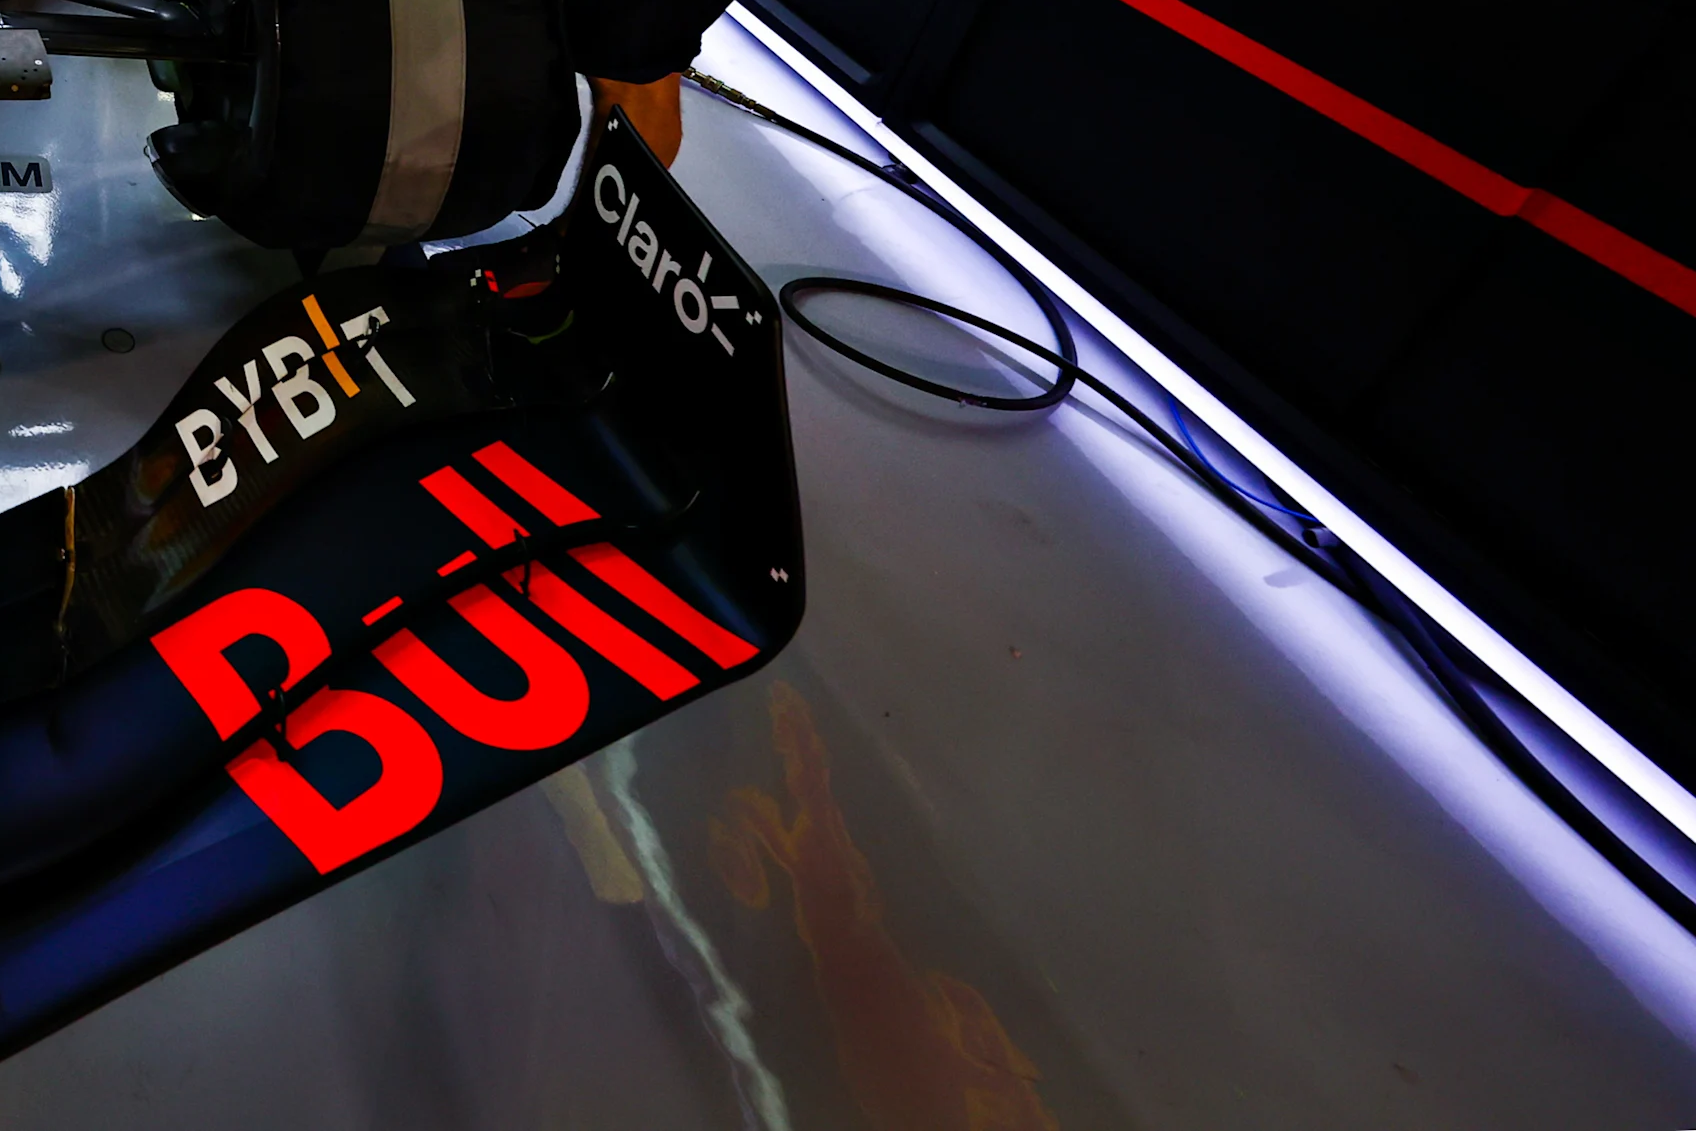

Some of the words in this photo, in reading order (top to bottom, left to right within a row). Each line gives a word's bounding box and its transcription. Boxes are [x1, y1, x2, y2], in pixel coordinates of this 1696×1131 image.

[594, 163, 728, 348] Claro
[175, 293, 417, 508] BYBIT
[150, 440, 761, 874] Bull
